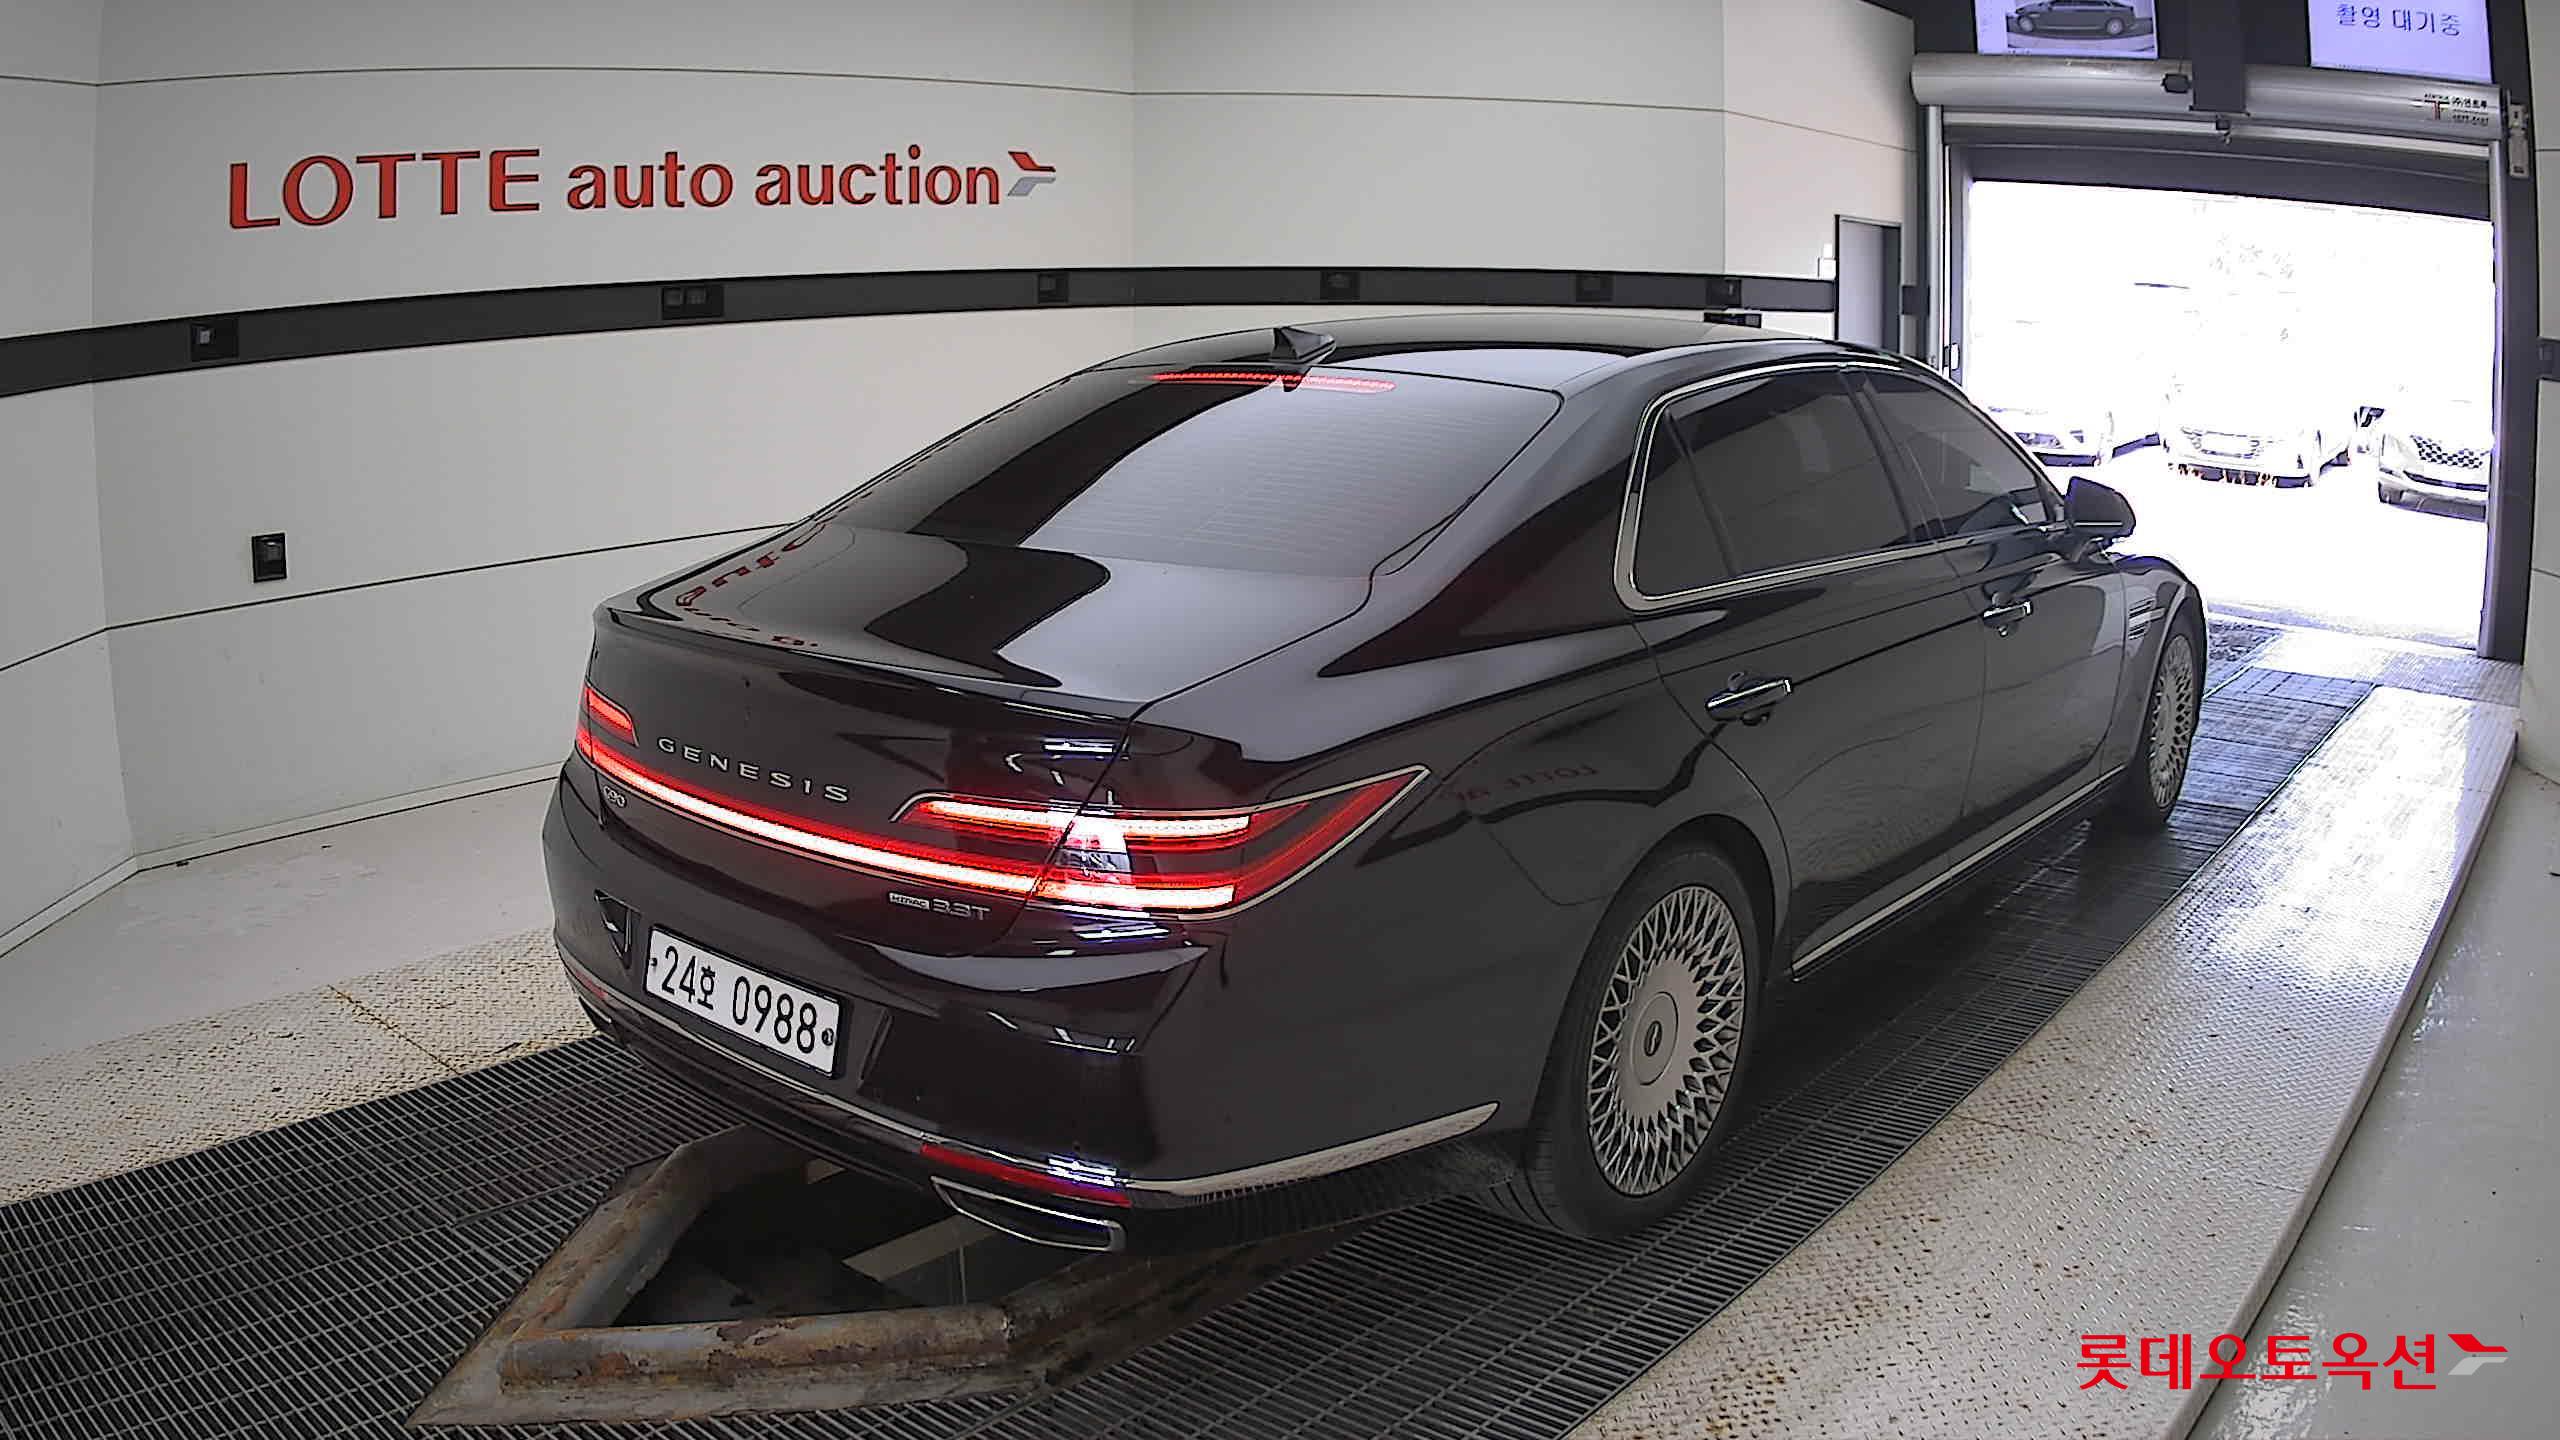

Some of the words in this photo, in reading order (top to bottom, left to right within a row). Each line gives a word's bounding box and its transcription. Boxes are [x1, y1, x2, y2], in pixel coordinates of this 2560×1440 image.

[2337, 4, 2380, 28] 촬영
[2392, 9, 2460, 36] 대기중
[229, 150, 541, 230] LOTTE
[566, 164, 735, 210] auto
[754, 145, 1002, 207] auction
[658, 738, 849, 803] GENESIS
[661, 945, 716, 1010] 24호
[732, 976, 817, 1054] 0988
